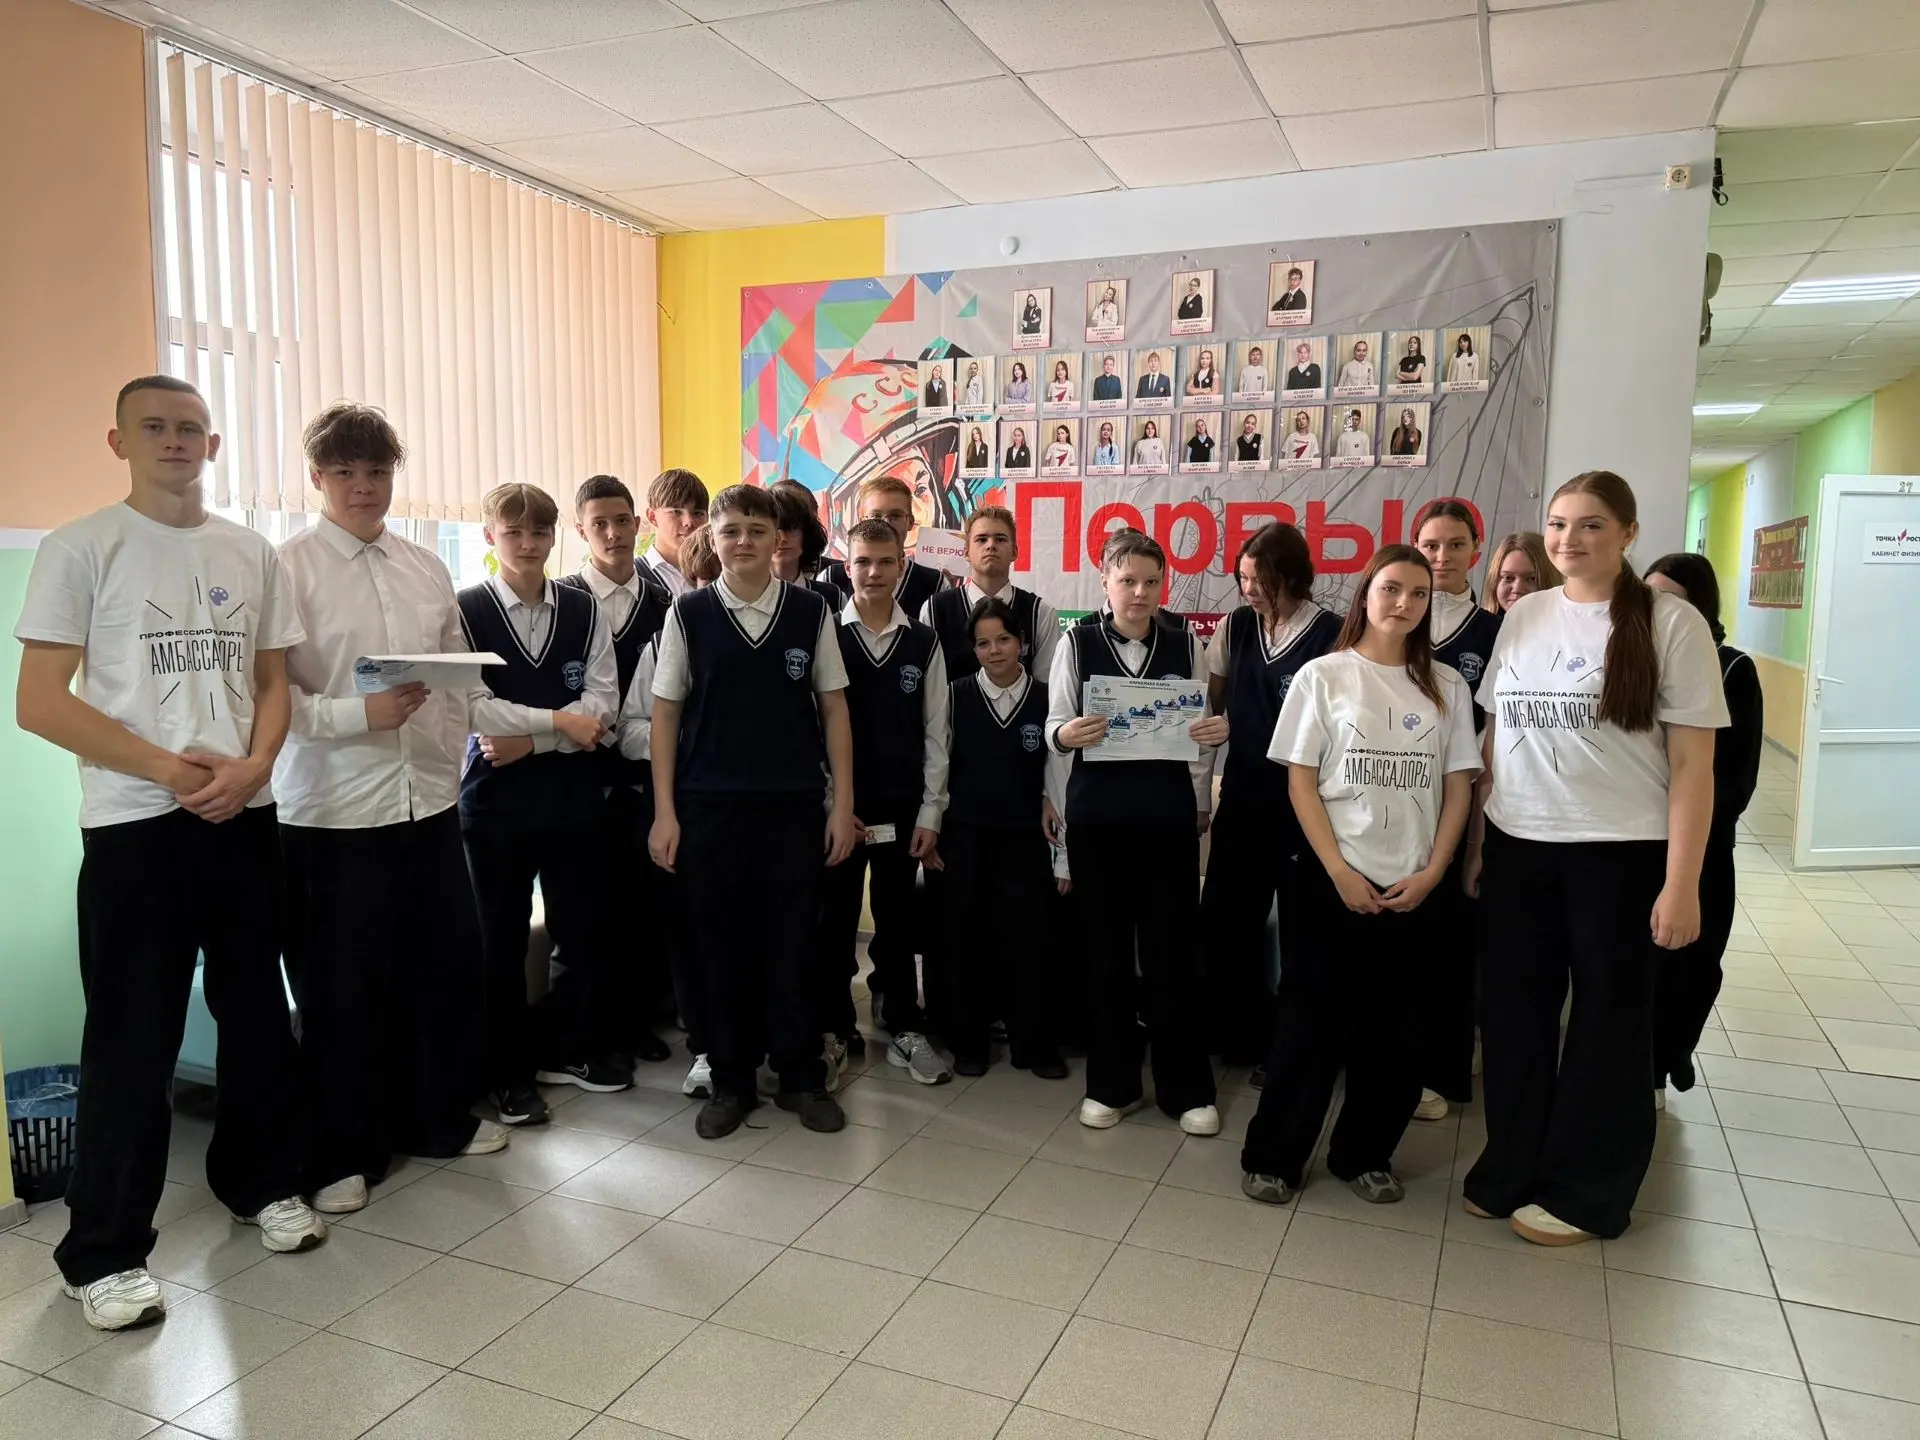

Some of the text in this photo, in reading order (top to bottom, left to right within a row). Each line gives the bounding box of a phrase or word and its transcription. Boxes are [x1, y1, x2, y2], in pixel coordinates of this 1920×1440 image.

[921, 545, 935, 554] НЕ
[1502, 700, 1600, 733] АМБАССАДОРЫ
[1343, 757, 1432, 791] АМБАССАДОРЫ
